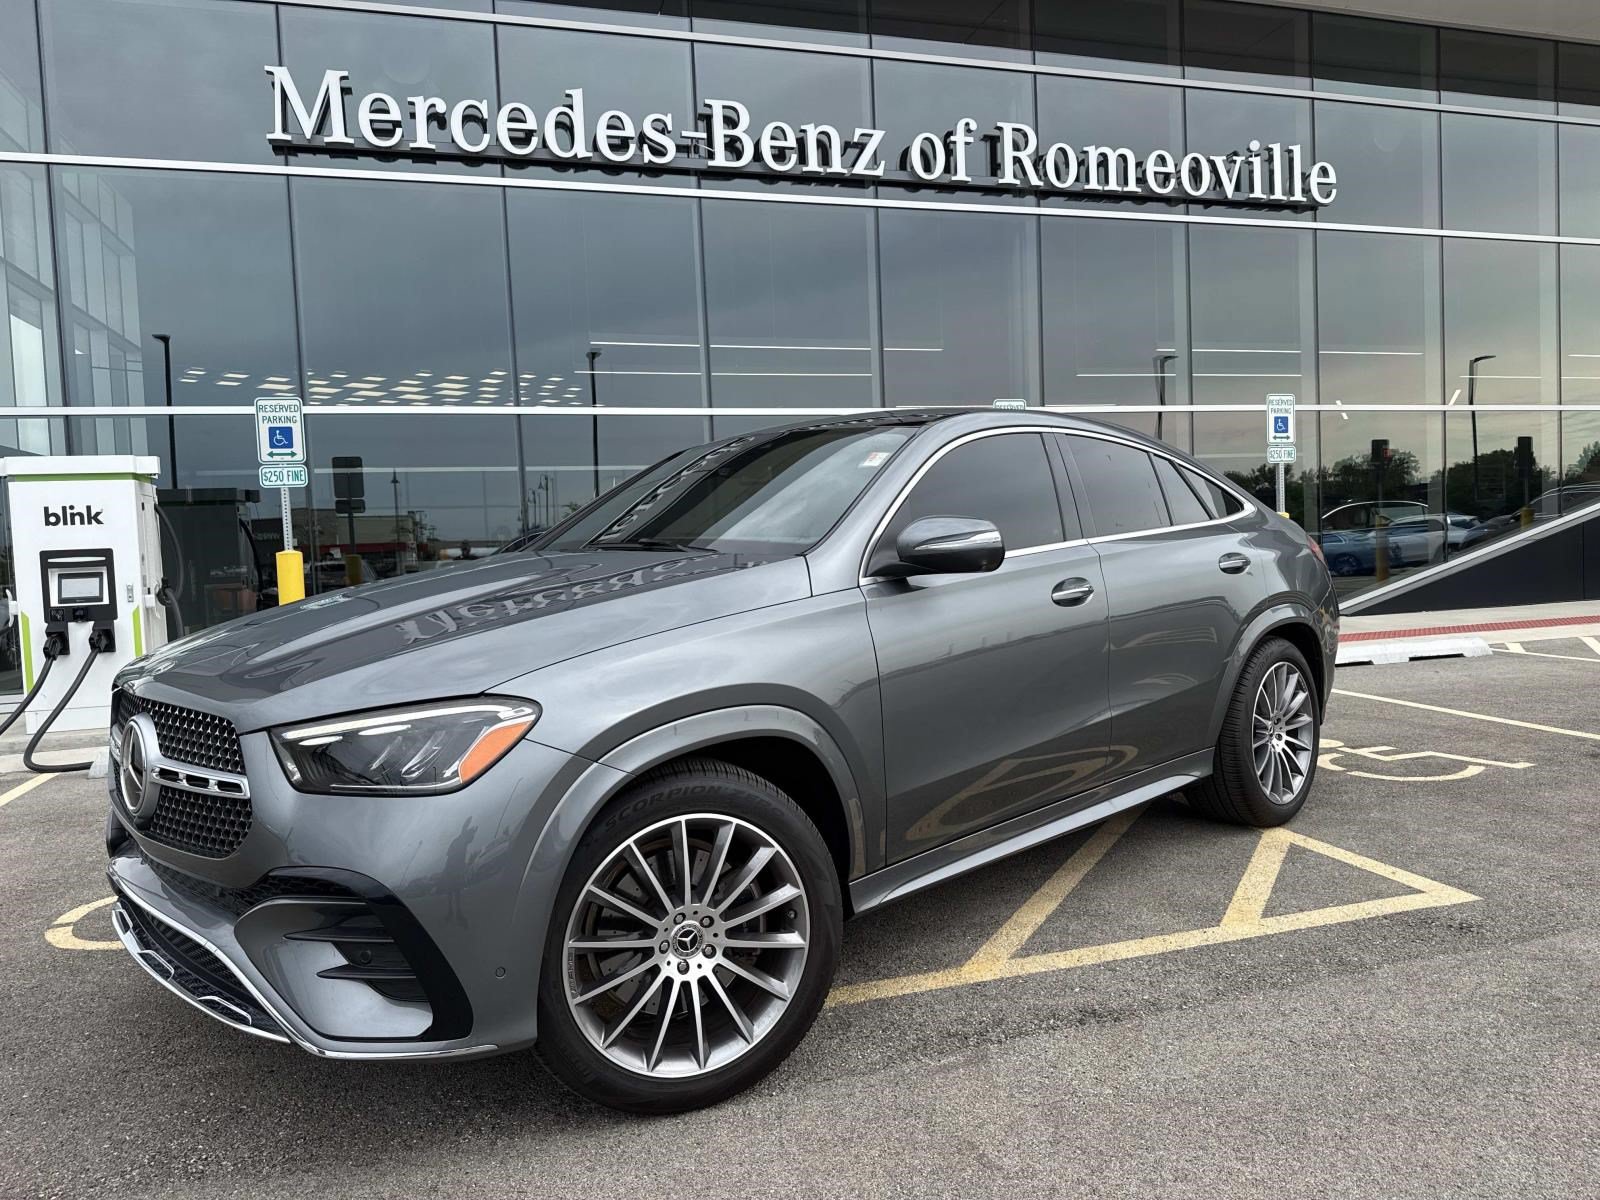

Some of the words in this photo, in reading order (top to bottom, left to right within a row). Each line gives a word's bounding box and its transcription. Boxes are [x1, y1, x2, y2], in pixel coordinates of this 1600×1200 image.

[264, 65, 885, 176] Mercedes-Benz
[910, 117, 978, 182] of
[996, 121, 1337, 204] Romeoville
[258, 404, 299, 413] RESERVED
[262, 415, 297, 424] PARKING
[1284, 450, 1294, 459] FINE
[263, 471, 284, 482] $250
[286, 470, 305, 482] FINE
[43, 505, 104, 526] blink
[605, 785, 722, 831] SCORPION
